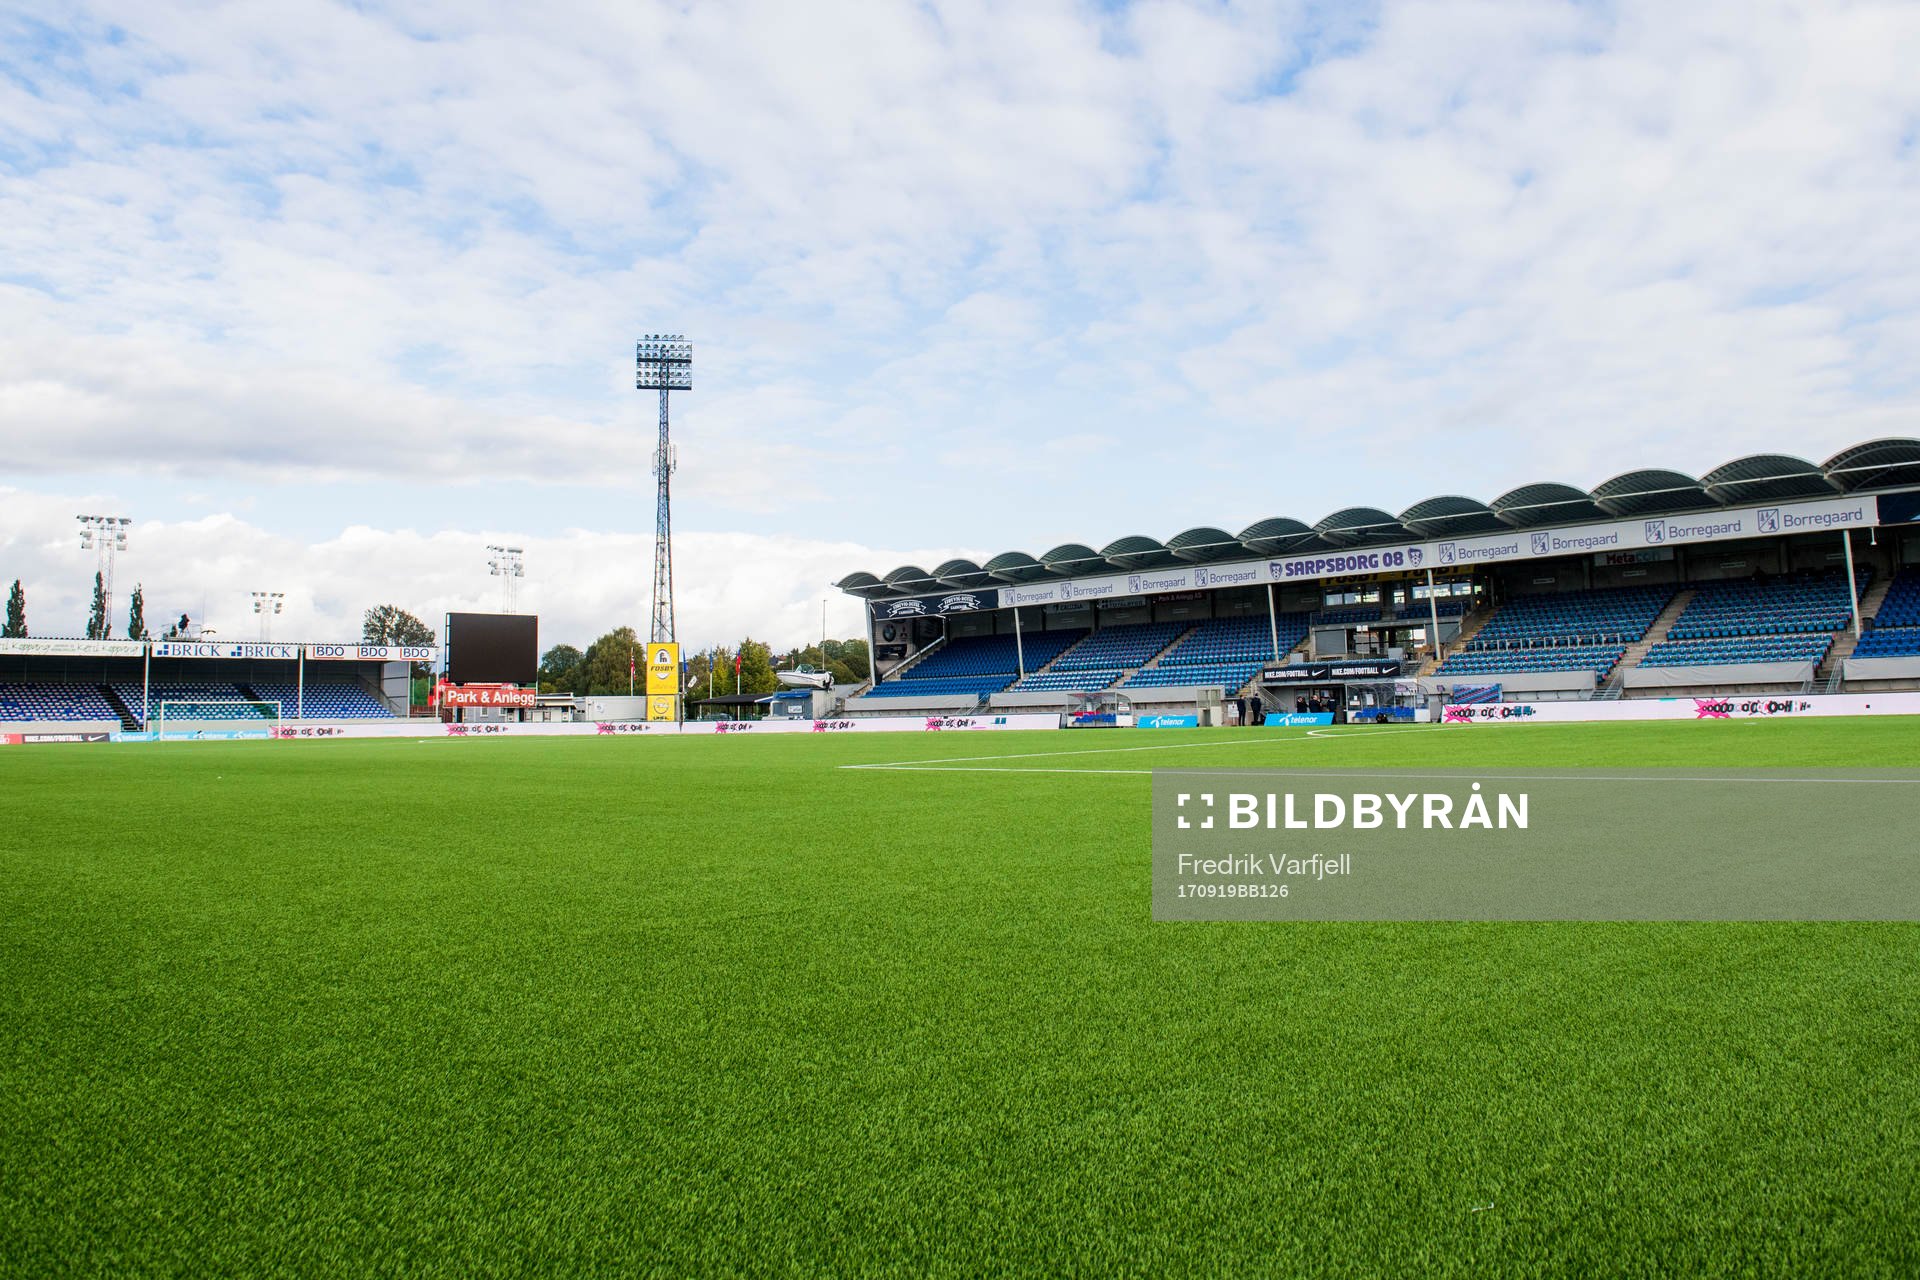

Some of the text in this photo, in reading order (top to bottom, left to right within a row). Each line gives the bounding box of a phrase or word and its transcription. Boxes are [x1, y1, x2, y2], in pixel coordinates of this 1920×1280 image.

[1784, 508, 1863, 527] Borregaard
[1669, 520, 1742, 538] Borregaard
[1552, 532, 1618, 549] Borregaard
[1458, 543, 1519, 559] Borregaard
[1285, 551, 1404, 577] SARPSBORG 08
[1142, 576, 1186, 590] Borregaard
[1210, 570, 1257, 584] Borregaard
[1016, 590, 1054, 602] Borregaard
[1073, 583, 1113, 597] Borregaard
[171, 645, 221, 657] BRICK
[244, 646, 291, 658] BRICK
[316, 646, 345, 657] BDO
[360, 647, 388, 658] BDO
[403, 648, 430, 658] BDO
[447, 690, 535, 705] Park & Anlegg
[1160, 717, 1185, 726] telenor
[1291, 714, 1318, 724] telenor
